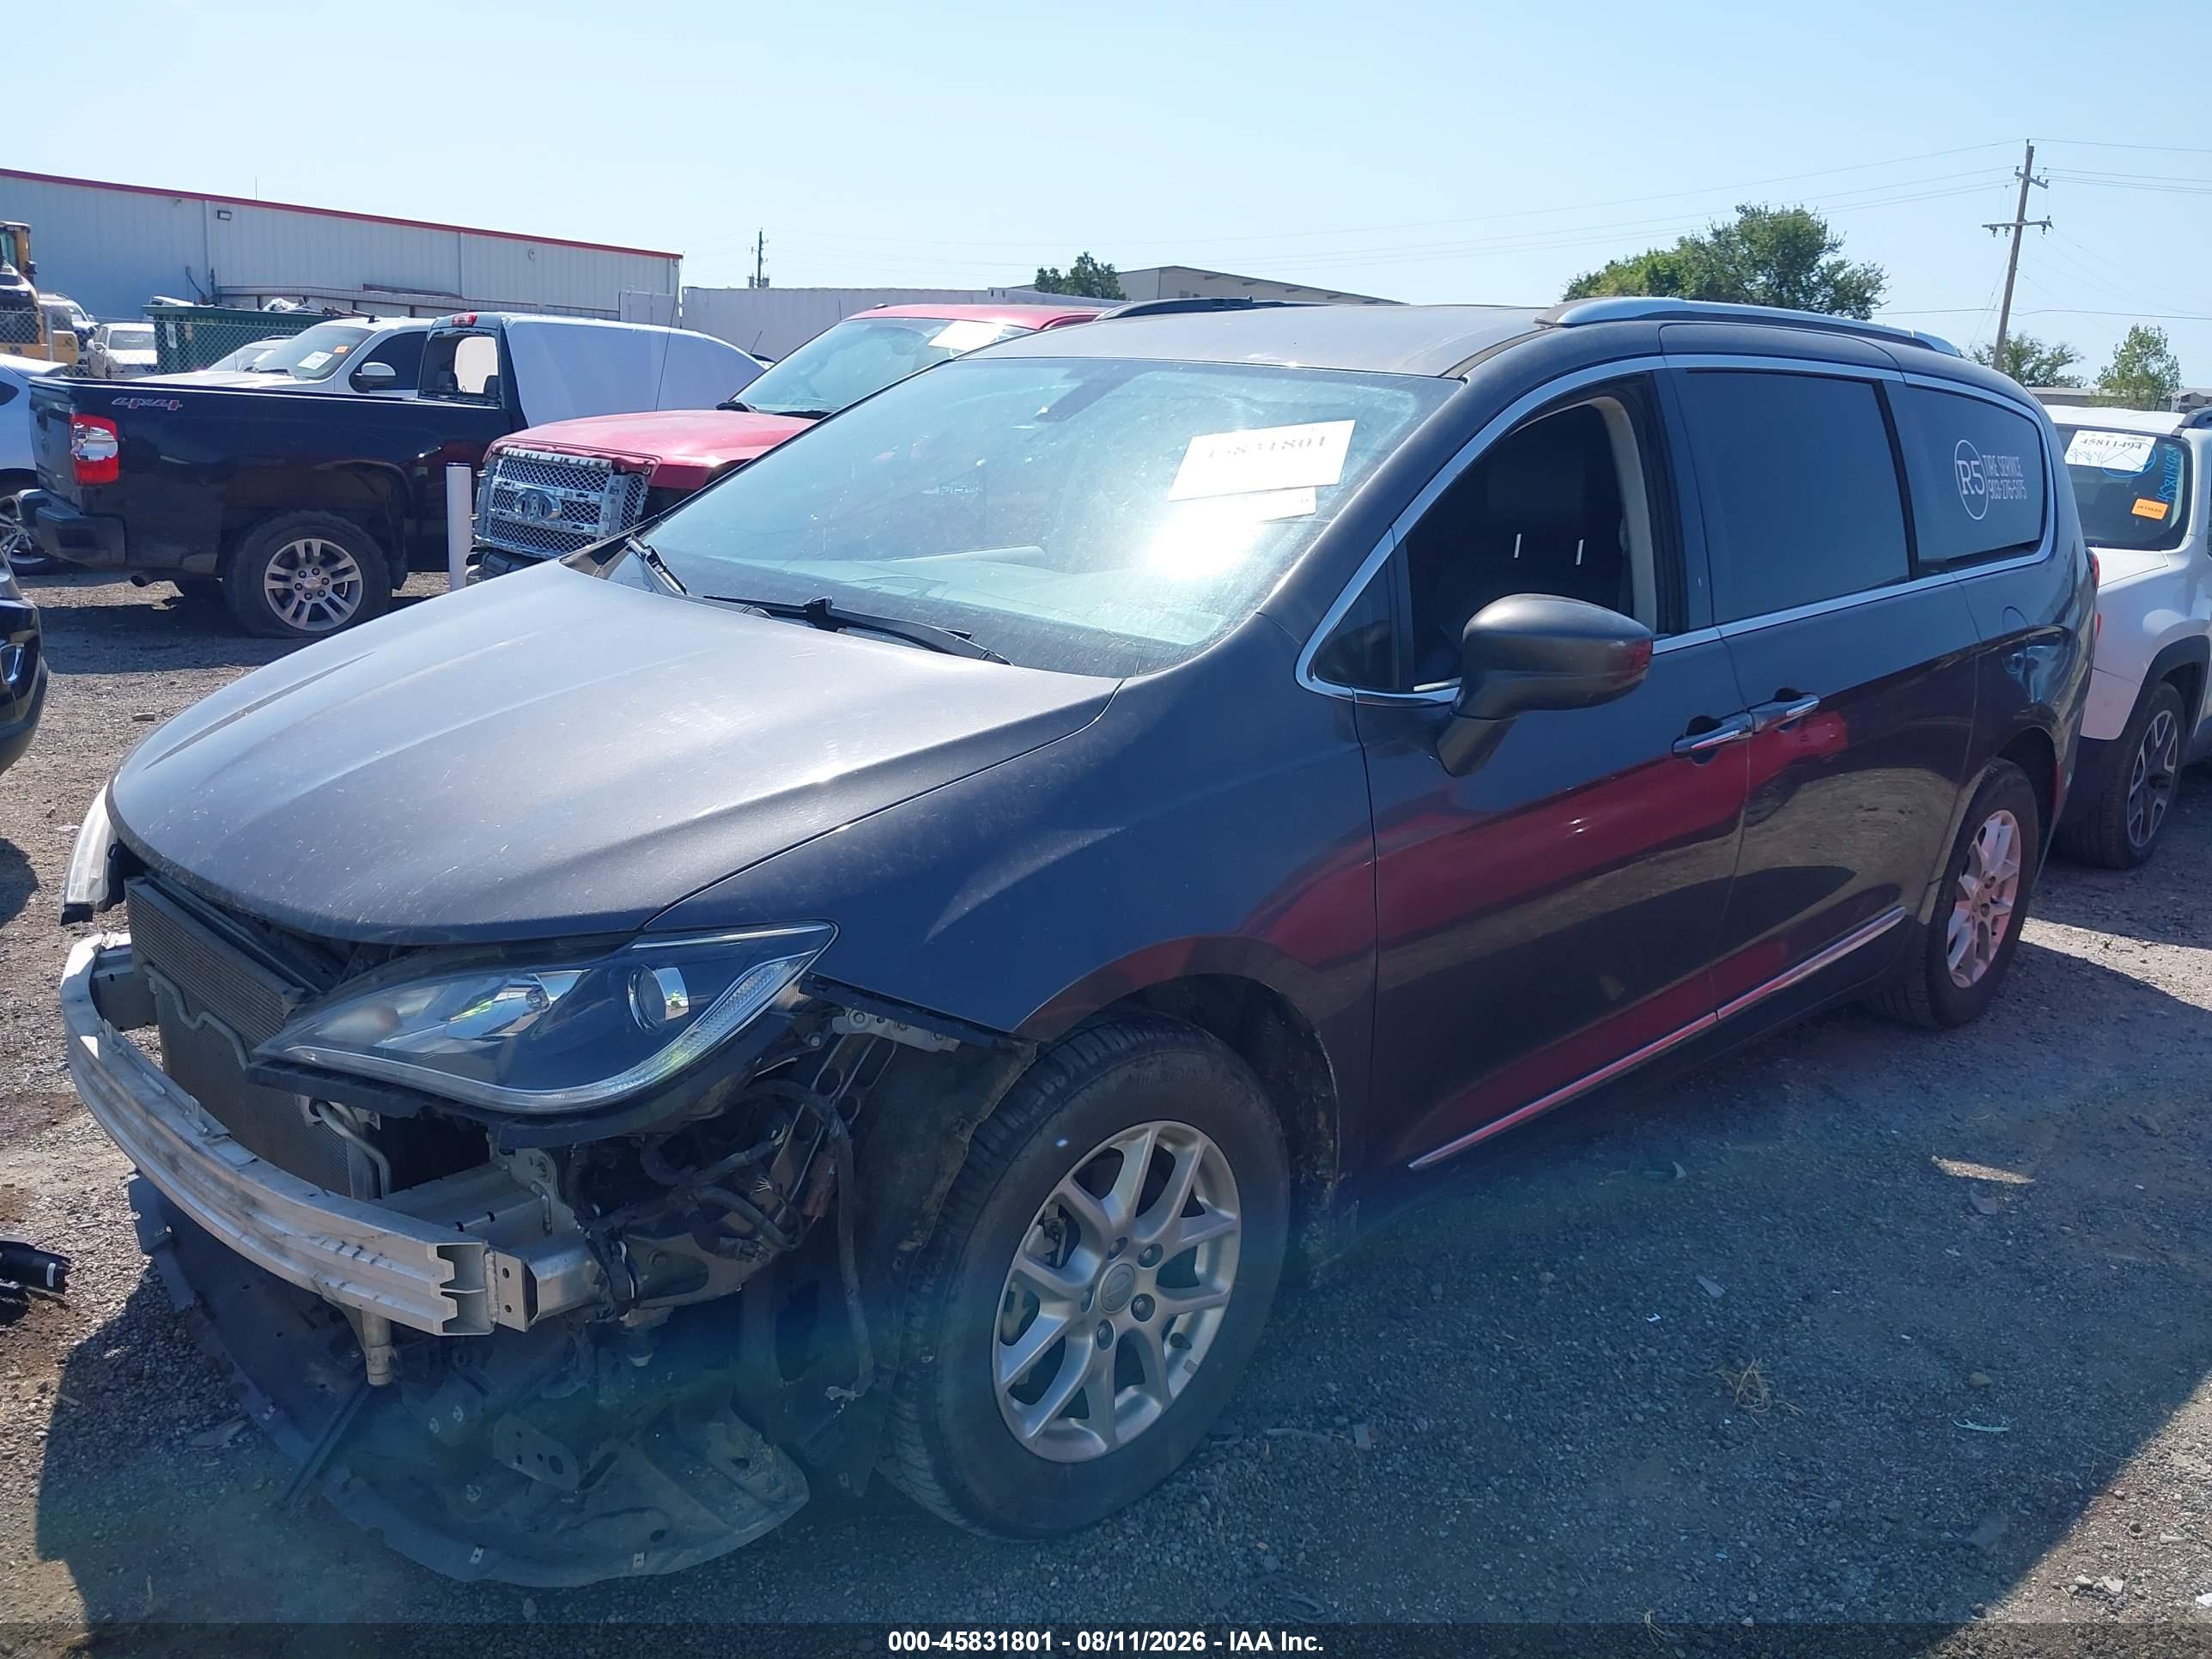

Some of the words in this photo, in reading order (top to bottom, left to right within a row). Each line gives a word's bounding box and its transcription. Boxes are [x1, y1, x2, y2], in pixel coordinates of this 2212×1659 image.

[2081, 437, 2142, 450] 45811494
[1956, 459, 1985, 495] R5
[1982, 454, 2000, 477] TIRE
